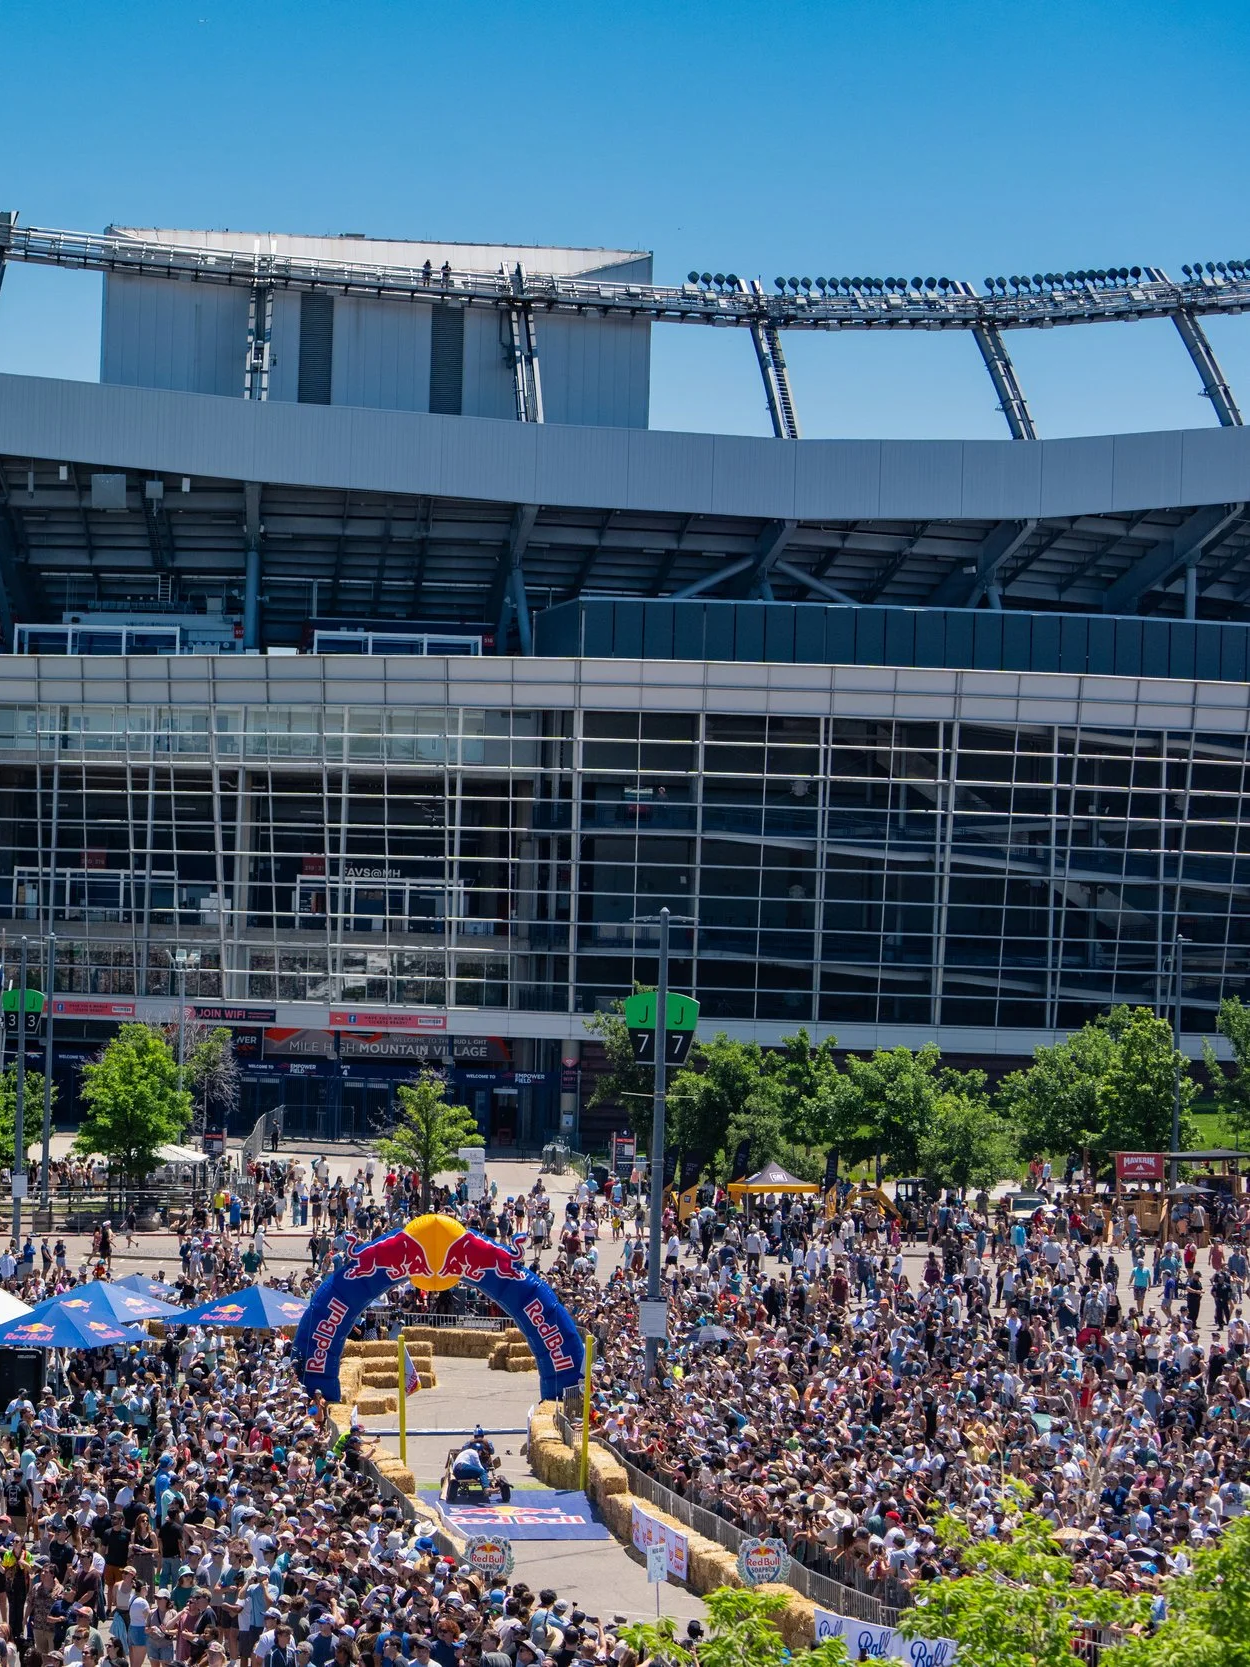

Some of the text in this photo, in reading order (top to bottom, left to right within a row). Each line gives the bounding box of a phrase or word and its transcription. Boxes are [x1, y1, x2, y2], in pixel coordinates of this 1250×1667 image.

[8, 1014, 16, 1027] 3
[198, 1009, 222, 1019] JOIN
[224, 1010, 246, 1019] WIFI
[638, 1005, 649, 1023] J
[674, 1006, 684, 1025] J
[28, 1015, 36, 1027] 3
[289, 1041, 319, 1052] MILE
[359, 1043, 429, 1055] MOUNTAIN
[638, 1034, 649, 1053] 7
[672, 1035, 684, 1054] 7
[1123, 1157, 1155, 1168] MAVERIK
[199, 1312, 243, 1322] Red Bull
[3, 1332, 54, 1341] Red Bull
[305, 1297, 349, 1374] Red Bull
[524, 1298, 575, 1372] Red Bull
[448, 1515, 587, 1525] Red Bull
[471, 1553, 505, 1564] Red Bull
[745, 1556, 781, 1566] Red Bull
[858, 1631, 891, 1659] Ball
[910, 1640, 948, 1667] Ball
